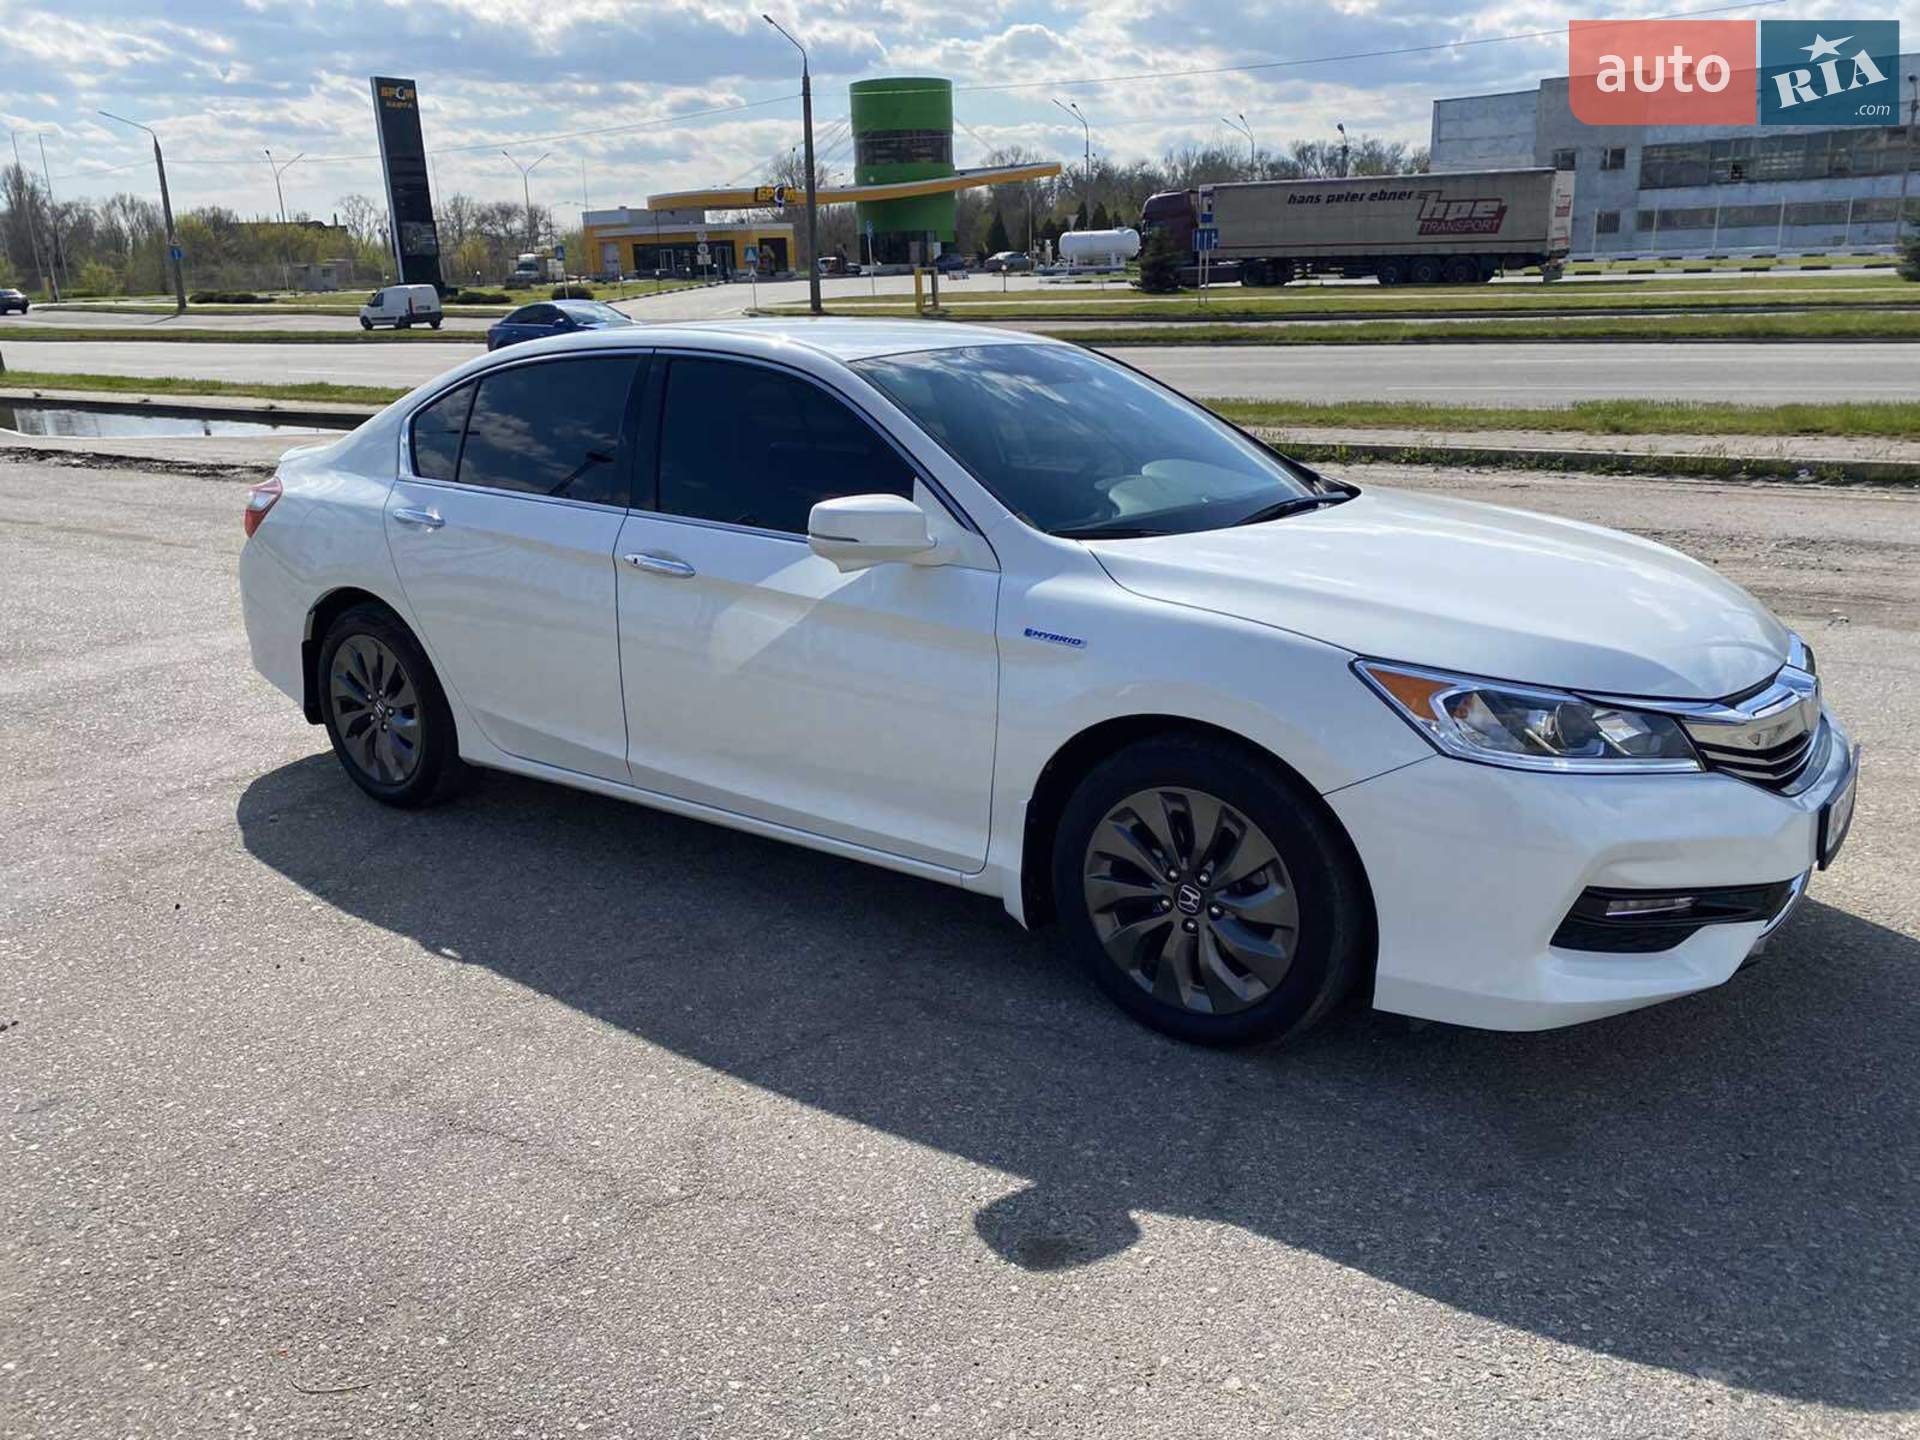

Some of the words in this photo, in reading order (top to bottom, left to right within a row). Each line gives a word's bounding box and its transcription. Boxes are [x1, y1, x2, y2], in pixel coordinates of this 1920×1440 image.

[1287, 193, 1322, 205] hans
[1325, 192, 1366, 204] peter
[1368, 190, 1415, 202] ebner
[1418, 191, 1502, 220] hpe
[1421, 219, 1499, 231] TRANSPORT
[1032, 631, 1081, 645] HYBRID
